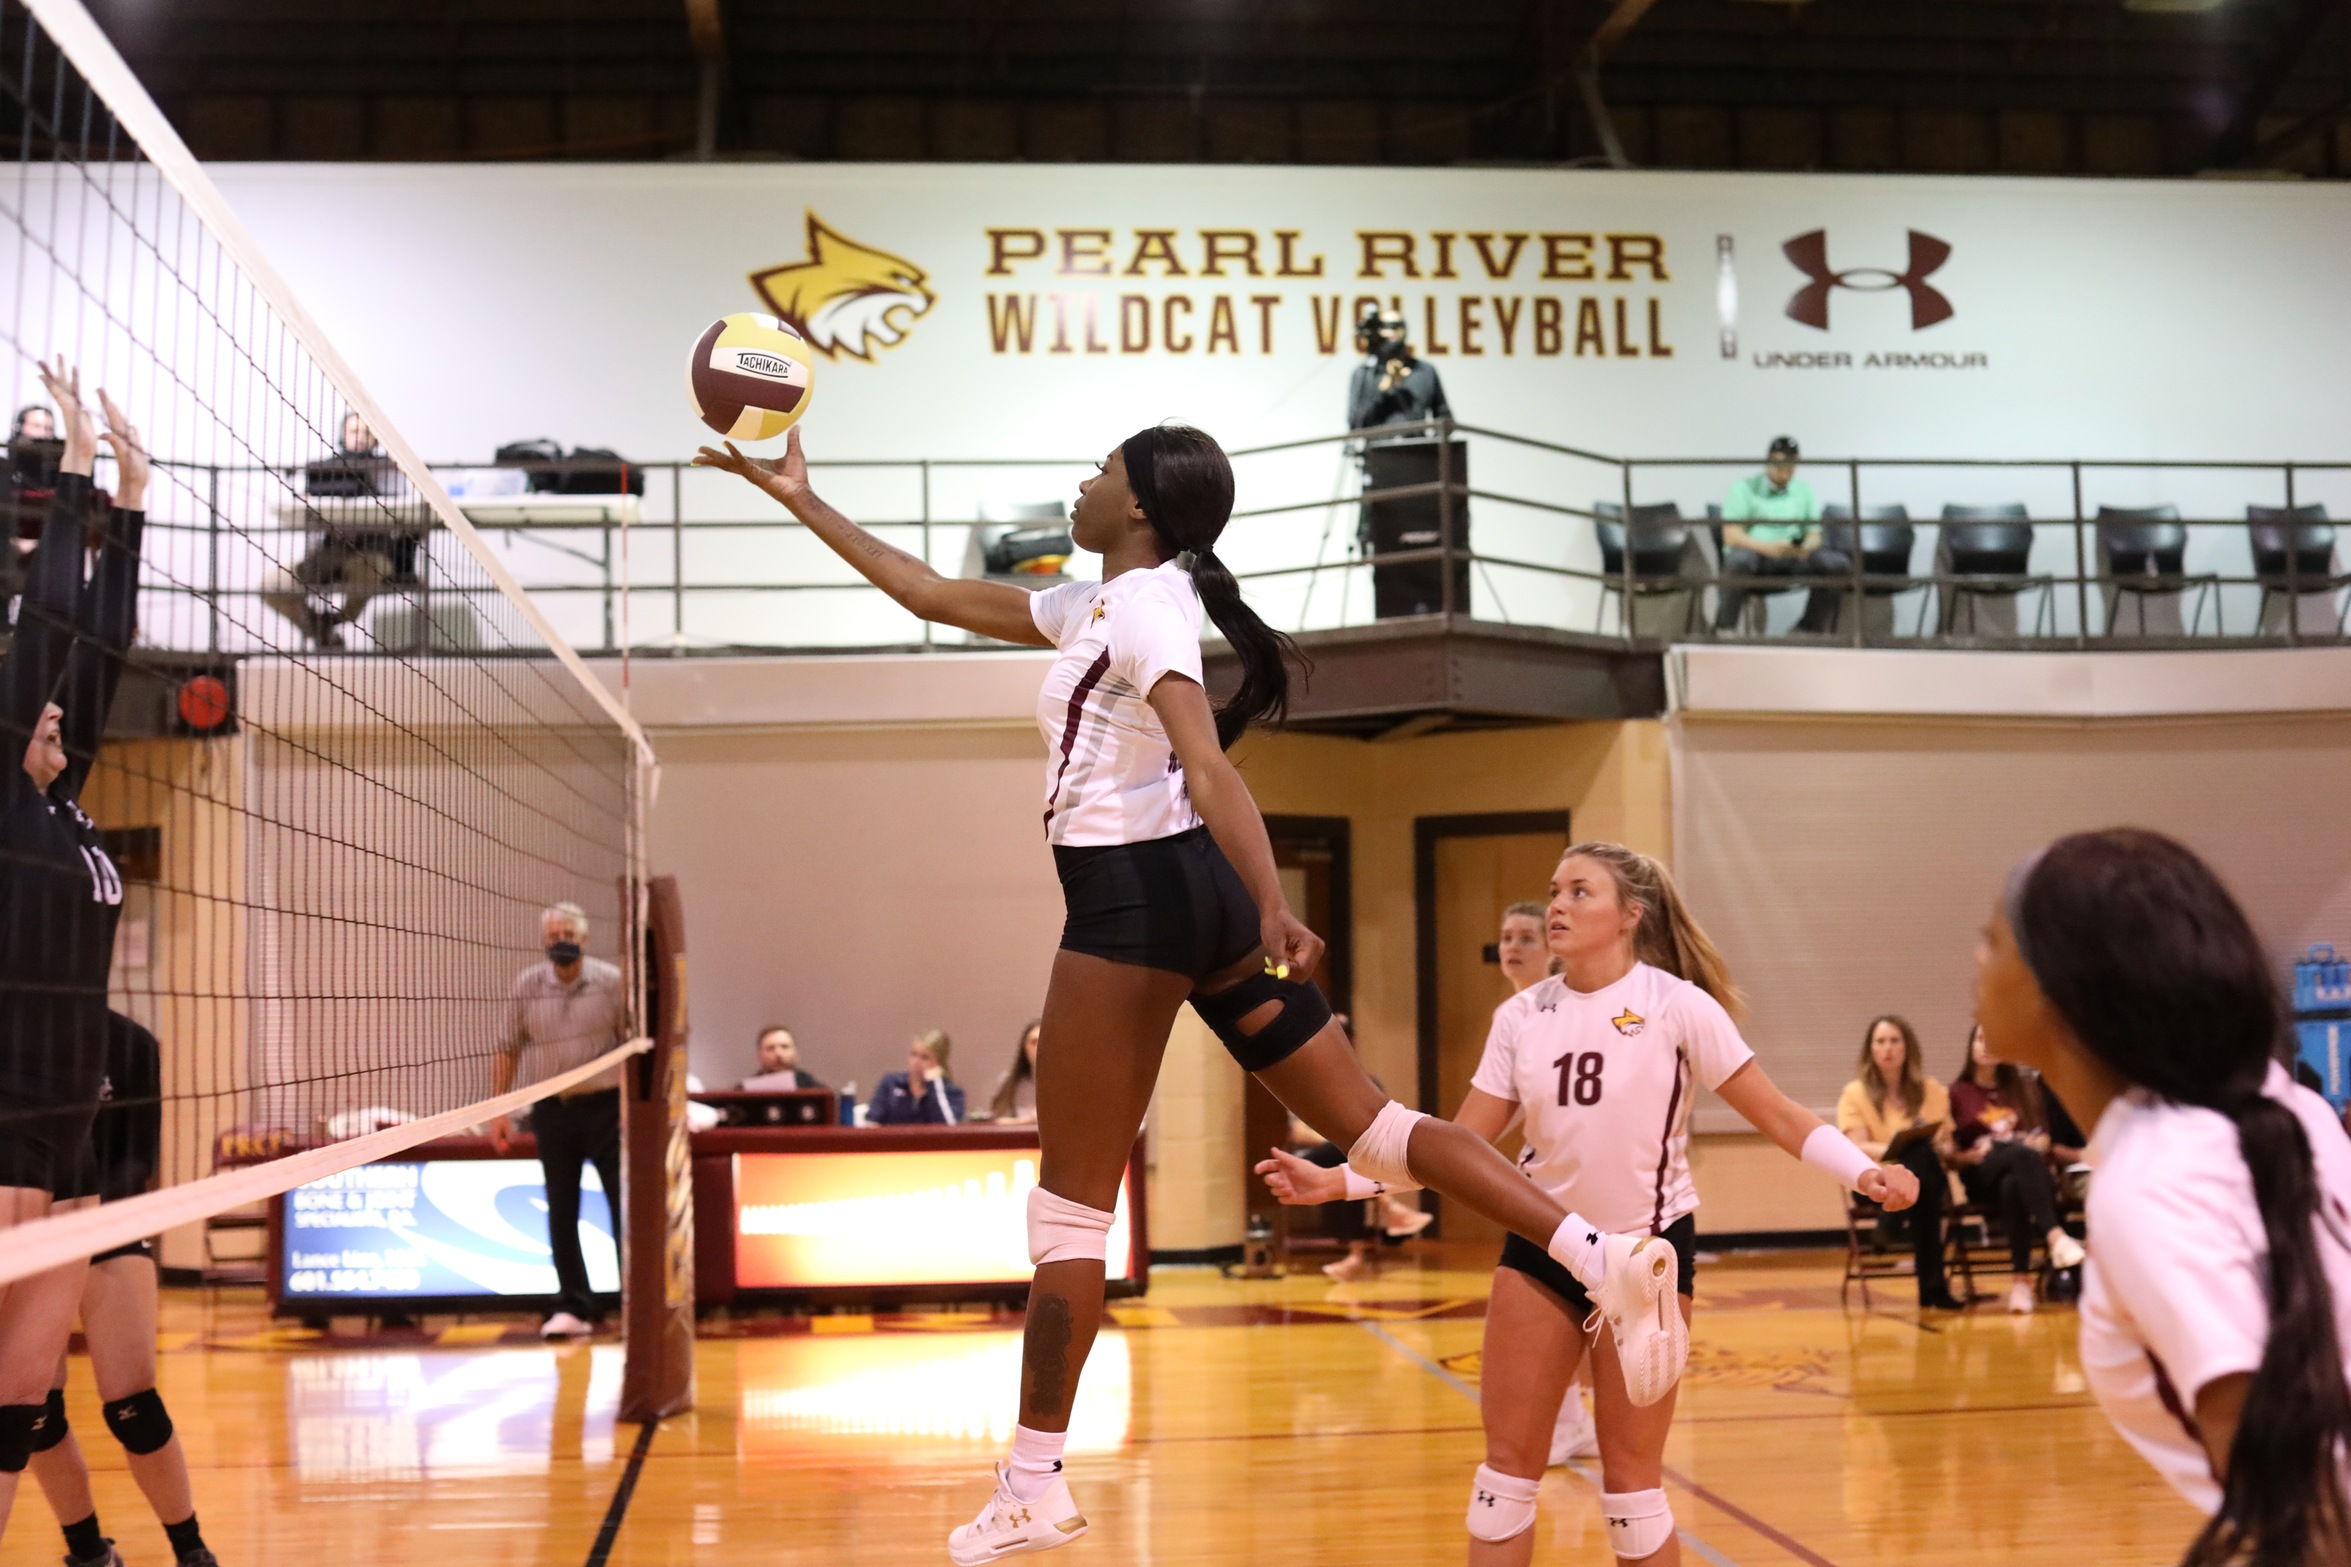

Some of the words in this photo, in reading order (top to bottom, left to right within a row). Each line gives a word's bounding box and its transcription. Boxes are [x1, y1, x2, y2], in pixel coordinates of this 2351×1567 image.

[985, 228, 1324, 278] PEARL
[1355, 229, 1671, 281] RIVER
[986, 292, 1283, 356] WILDCAT
[1310, 293, 1674, 358] VLEYBALL
[738, 353, 789, 374] TACHIKARA
[1753, 351, 1853, 368] UNDER
[1864, 352, 1989, 369] ARMOUR
[1552, 1051, 1604, 1107] 18
[297, 1165, 418, 1189] UTHERN
